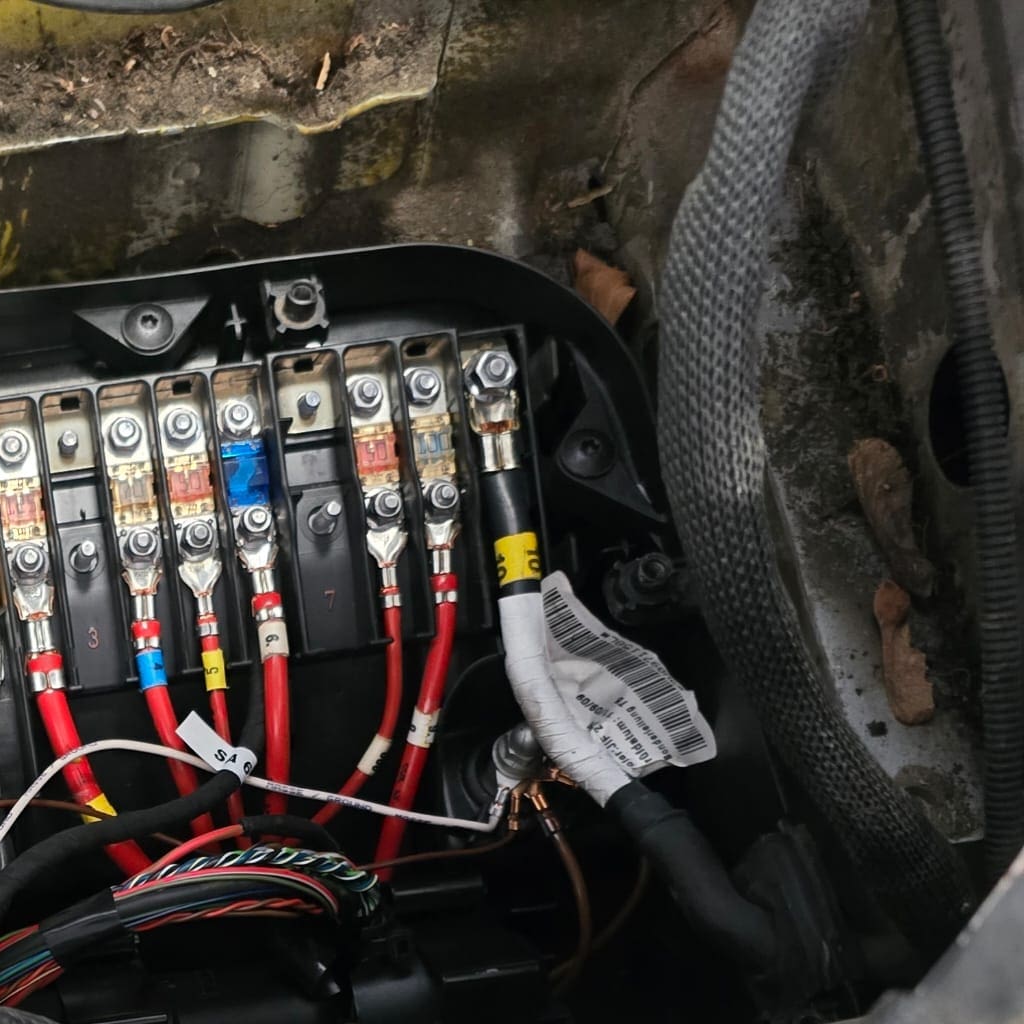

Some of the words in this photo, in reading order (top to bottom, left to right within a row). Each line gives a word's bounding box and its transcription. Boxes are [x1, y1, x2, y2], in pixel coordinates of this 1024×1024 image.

[324, 590, 336, 609] 7
[88, 627, 99, 648] 3
[214, 749, 238, 764] SA
[243, 761, 253, 775] 6
